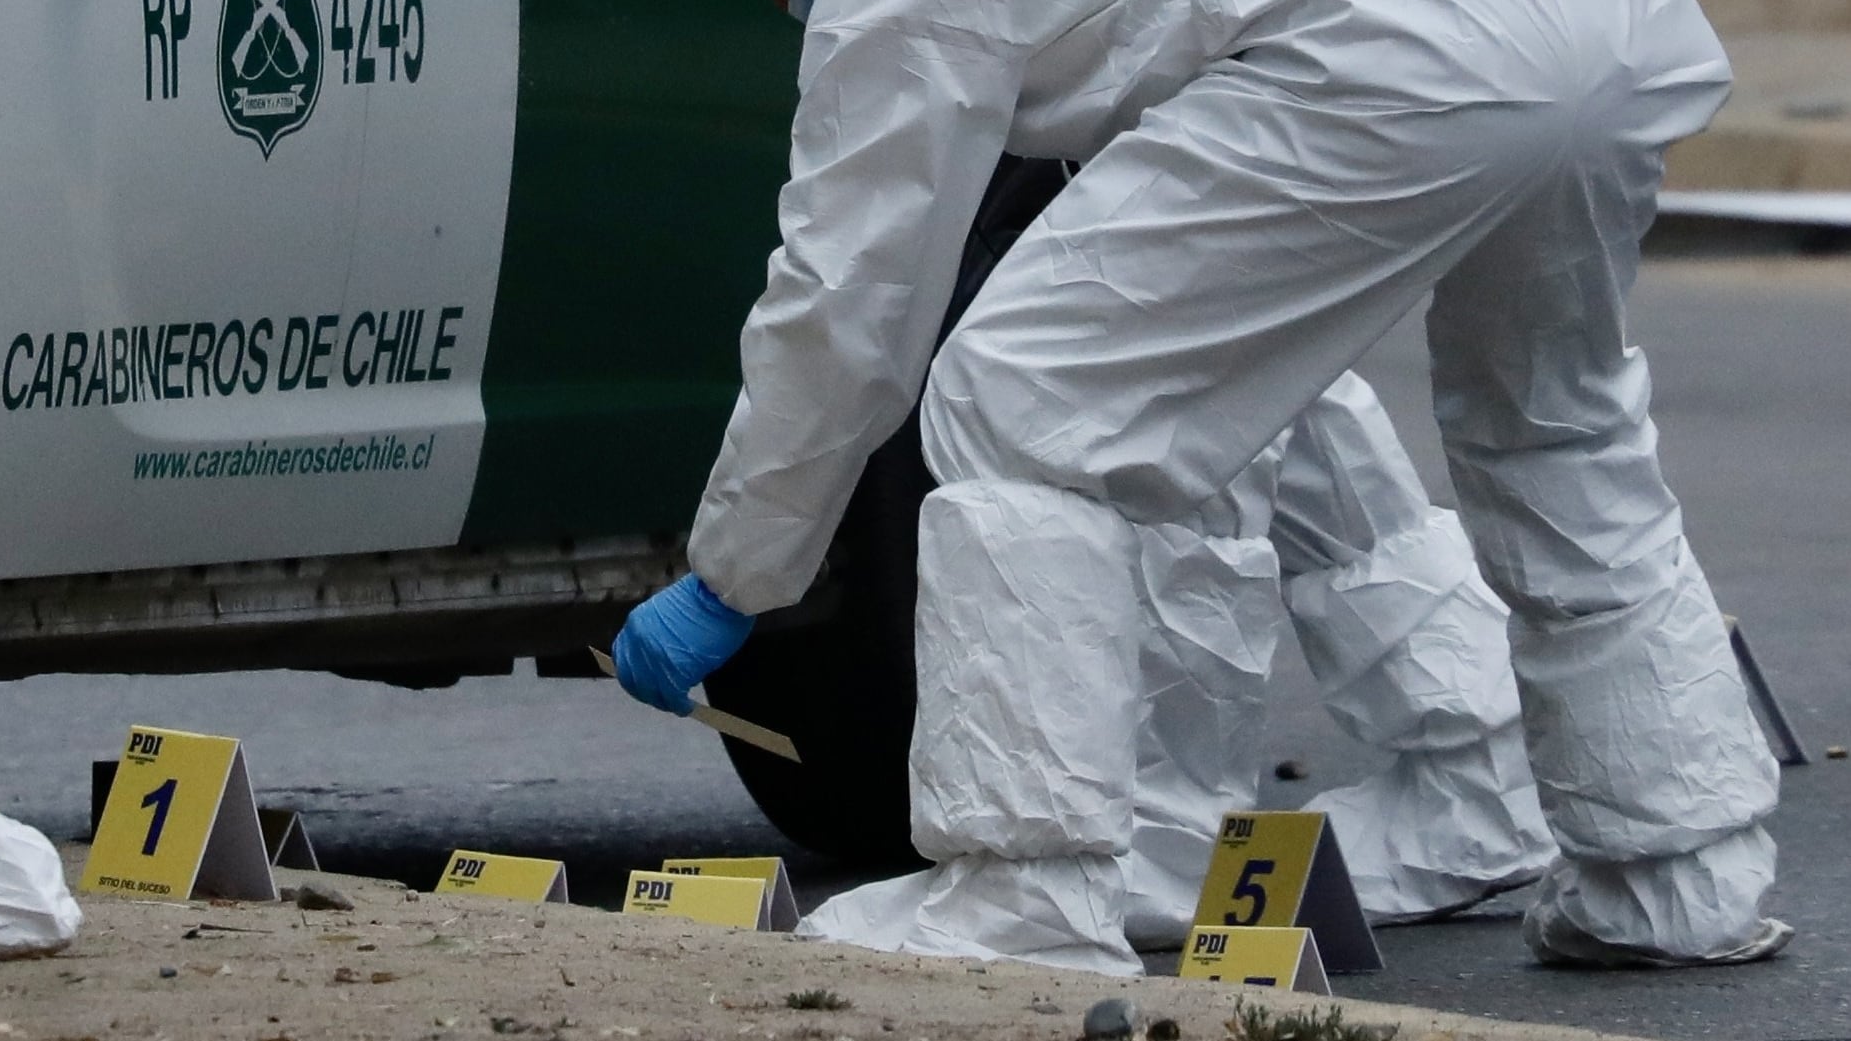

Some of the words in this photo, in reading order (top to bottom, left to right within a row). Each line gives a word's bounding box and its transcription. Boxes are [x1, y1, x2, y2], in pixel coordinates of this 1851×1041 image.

[2, 316, 274, 411] CARABINEROS
[277, 313, 340, 393] DE
[342, 306, 464, 389] CHILE
[133, 433, 435, 480] www.carabinerosdechile.cl
[128, 732, 163, 756] PDI
[140, 778, 178, 857] 1
[1223, 818, 1255, 838] PDI
[450, 857, 487, 878] PDI
[98, 875, 120, 888] SITIO
[120, 878, 136, 891] DEL
[137, 880, 171, 895] SUCESO
[634, 879, 675, 902] PDI
[1223, 859, 1276, 927] 5
[1193, 933, 1229, 955] PDI
